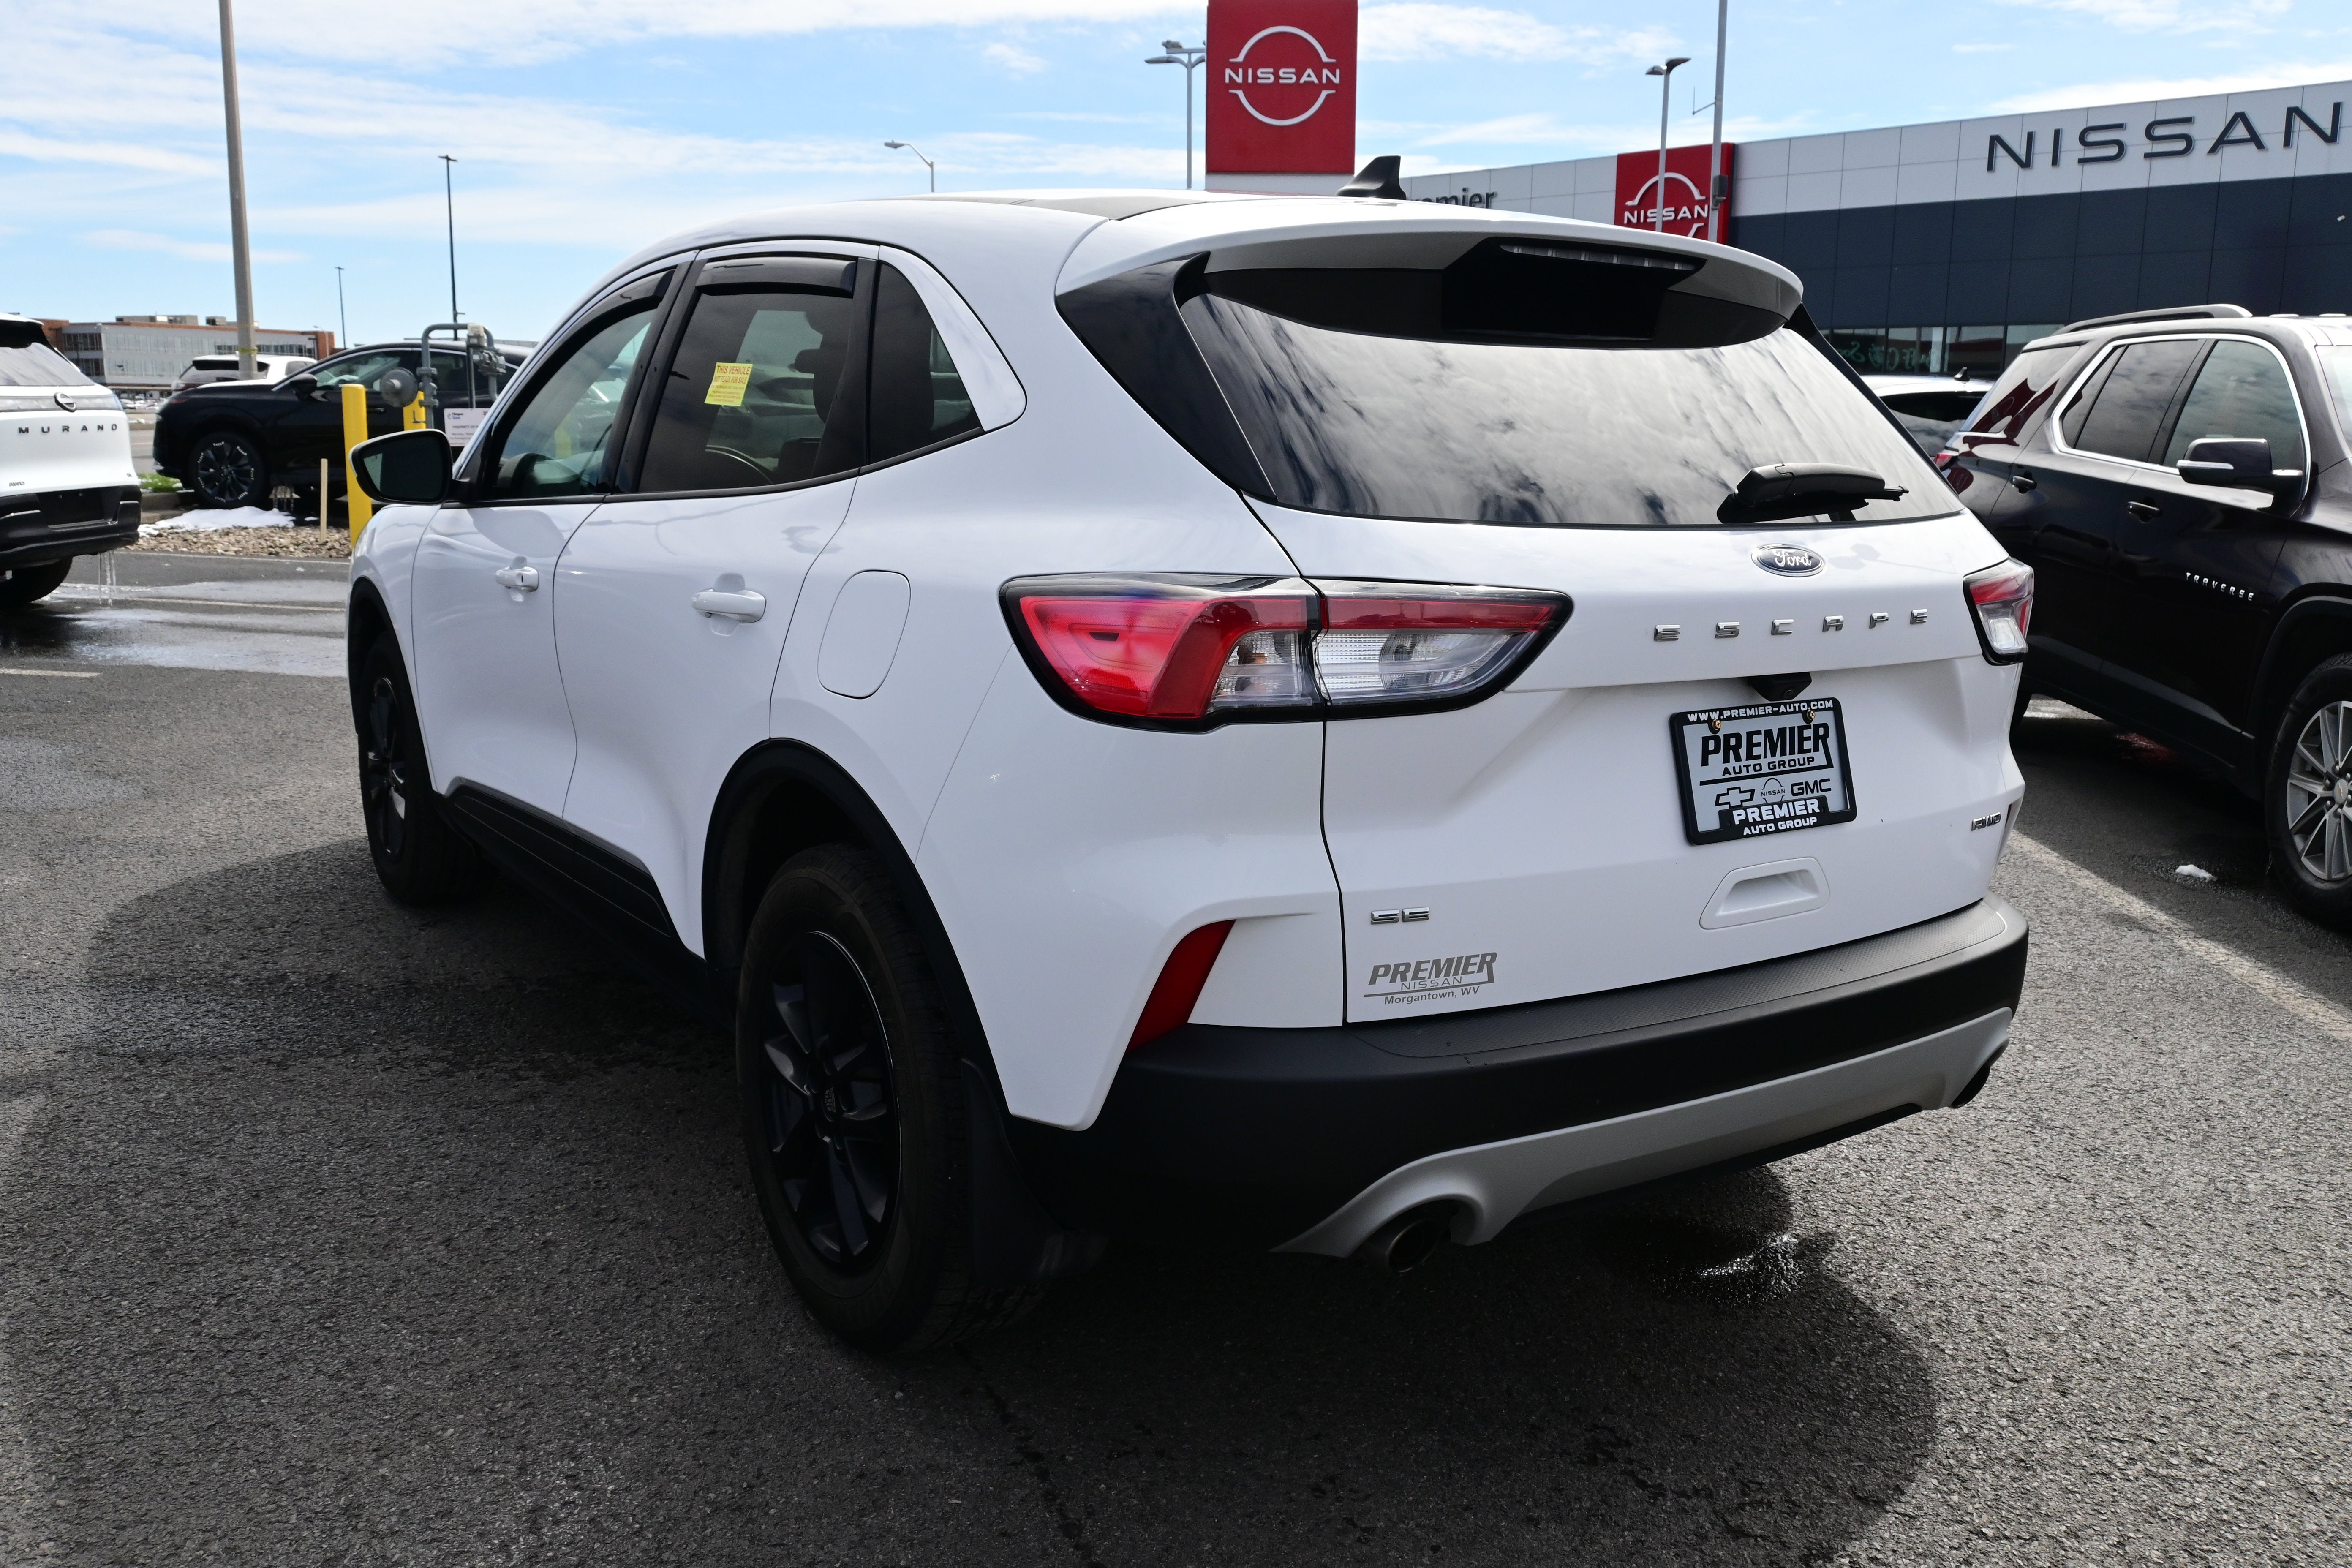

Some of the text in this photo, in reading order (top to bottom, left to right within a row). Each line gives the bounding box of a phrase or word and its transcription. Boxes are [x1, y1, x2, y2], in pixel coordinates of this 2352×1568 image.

[1225, 68, 1340, 84] NISSAN
[1987, 101, 2341, 172] NISSAN
[1624, 204, 1708, 224] NISSAN
[716, 365, 751, 375] THIS VEHICLE
[18, 424, 117, 433] MURANO
[1772, 549, 1812, 567] Ford
[2186, 572, 2254, 602] TRAVERSE
[1653, 608, 1928, 642] ESCAPE
[1687, 700, 1833, 722] WWW.PREMIER-AUTO.COM
[1701, 722, 1834, 768] PREMIER
[1722, 756, 1816, 776] AUTO GROUP
[1761, 788, 1786, 797] NISSAN
[1790, 778, 1832, 797] GMC
[1732, 798, 1821, 825] PREMIER
[1743, 817, 1818, 836] AUTO GROUP
[1971, 812, 2001, 832] AWD
[1370, 907, 1430, 925] SE
[1368, 952, 1497, 985] PREMIER
[1401, 976, 1462, 991] NISSAN
[1384, 986, 1480, 1004] Morgantown, WV
